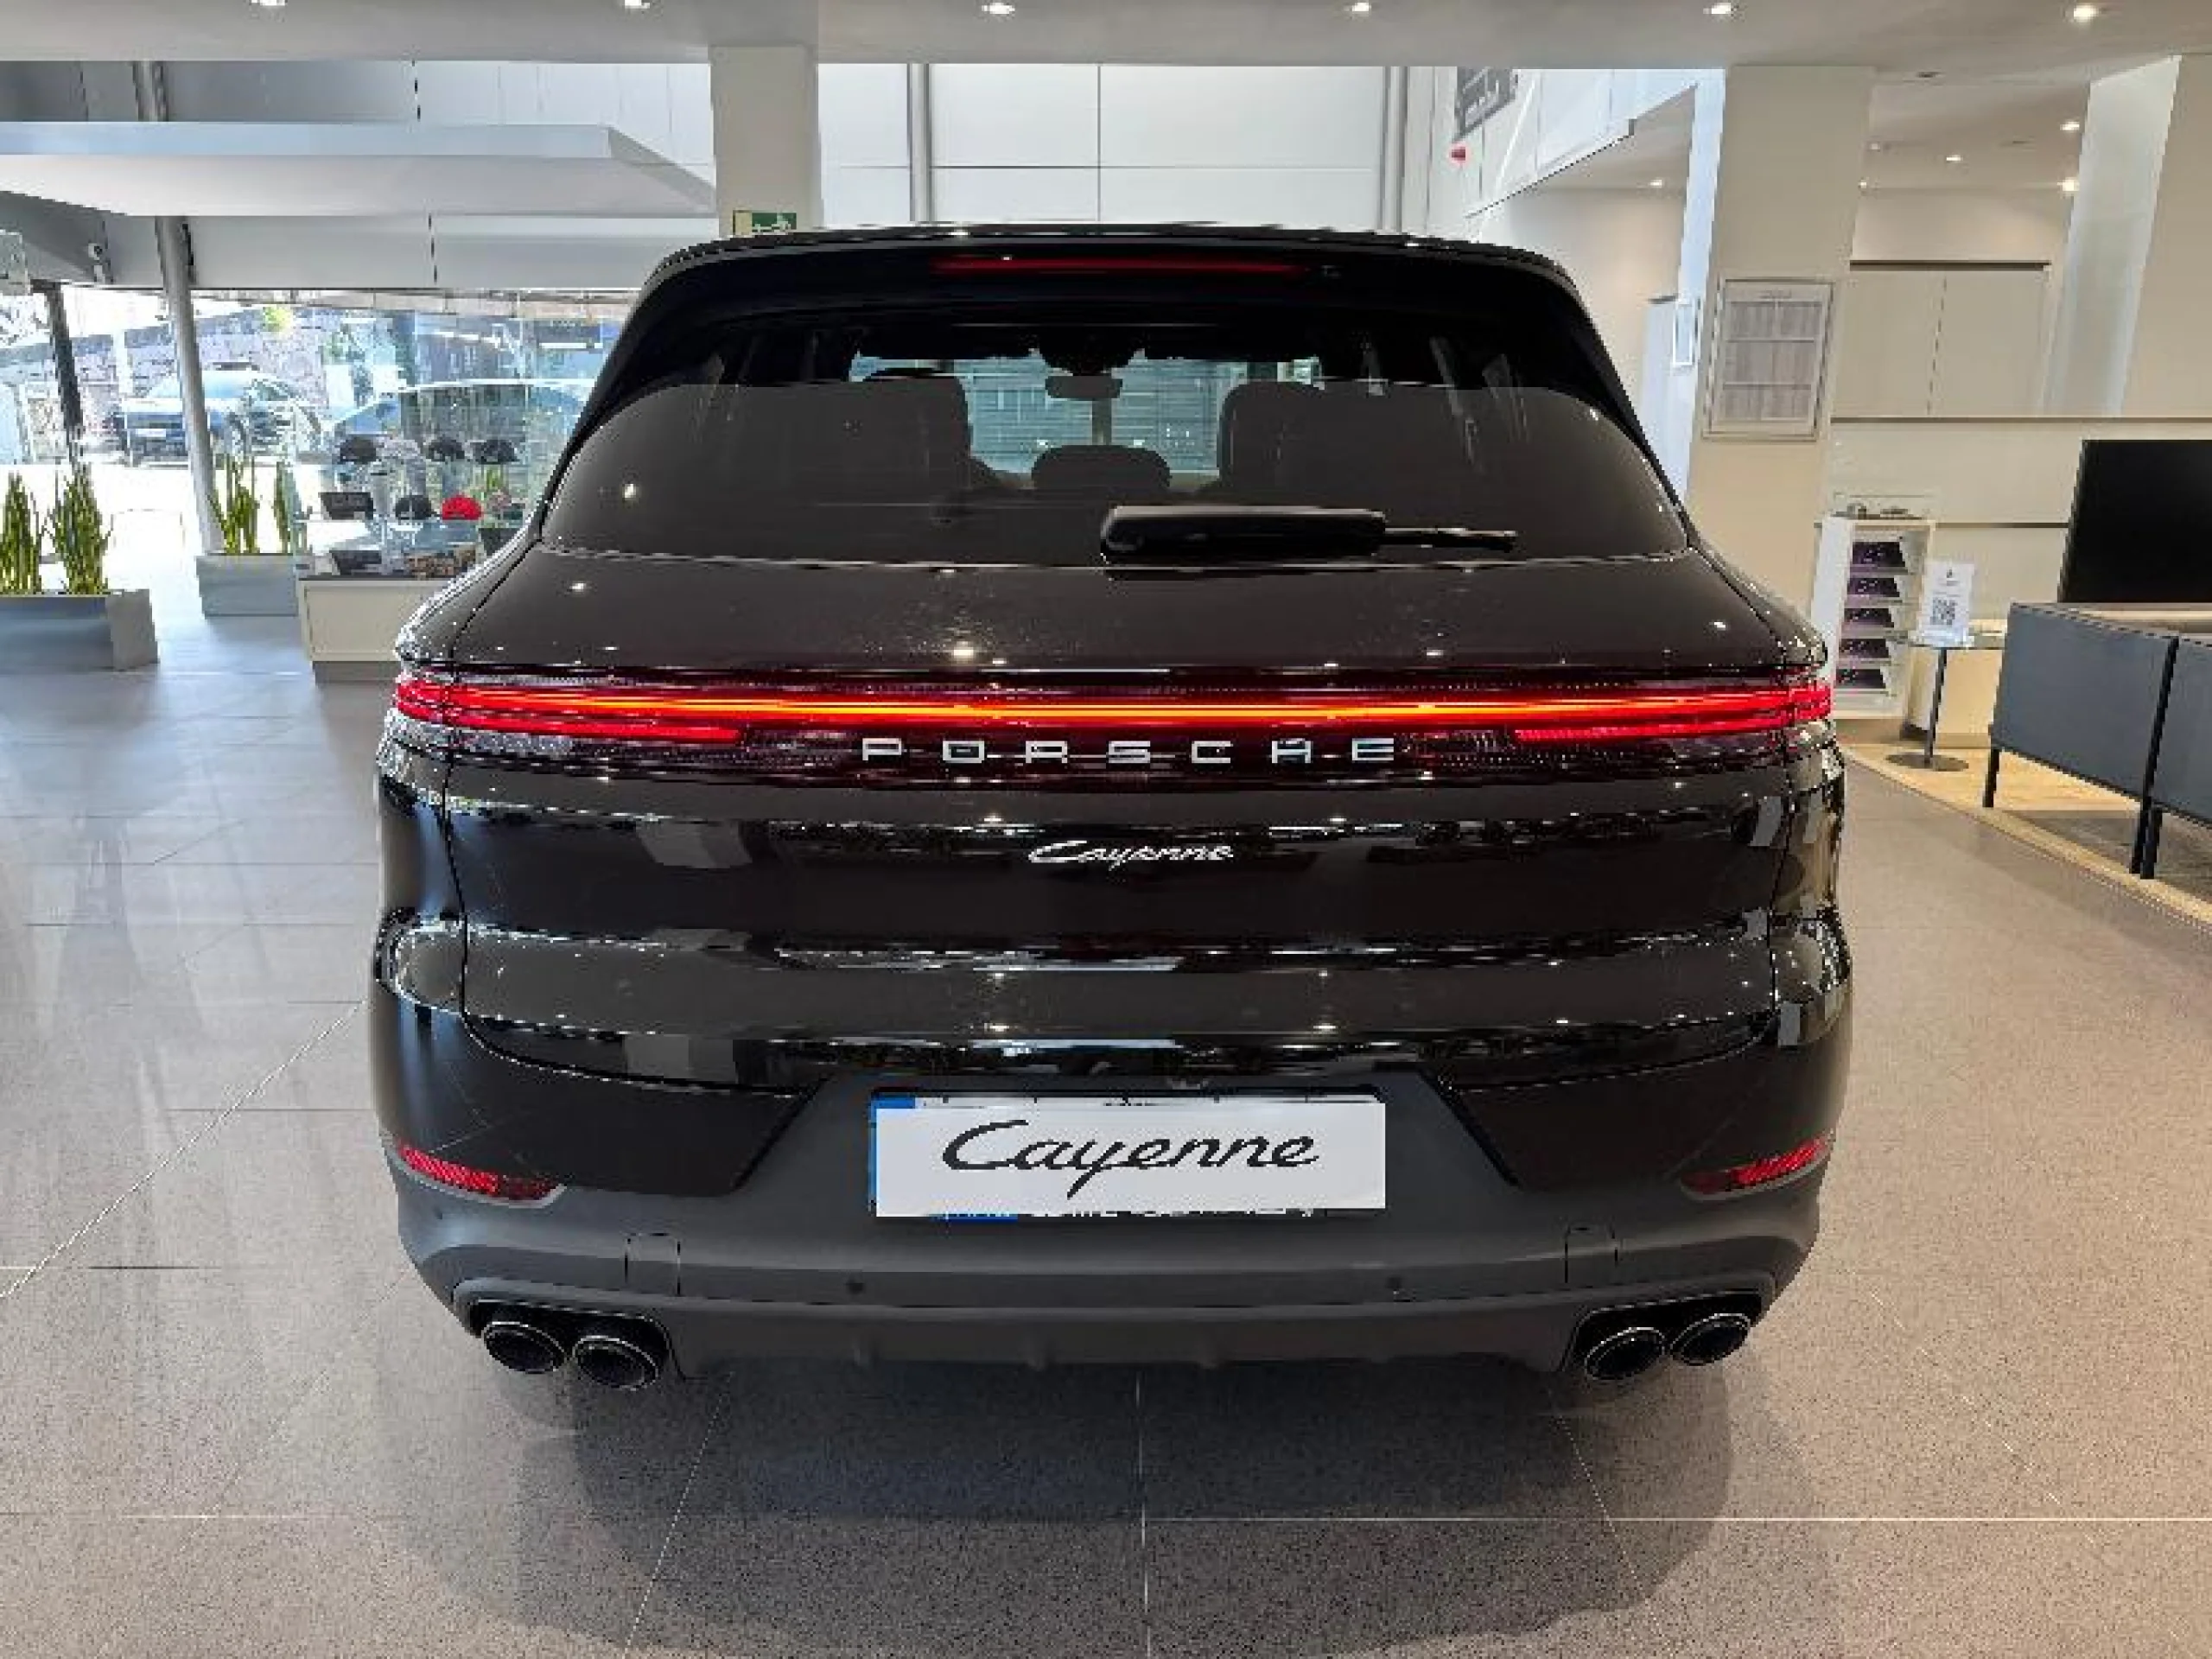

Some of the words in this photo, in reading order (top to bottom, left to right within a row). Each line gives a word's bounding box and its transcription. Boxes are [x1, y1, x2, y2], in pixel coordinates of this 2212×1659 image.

[861, 737, 1395, 765] PORSCHE
[1028, 840, 1234, 871] Cayenne
[943, 1119, 1319, 1200] Cayenne
